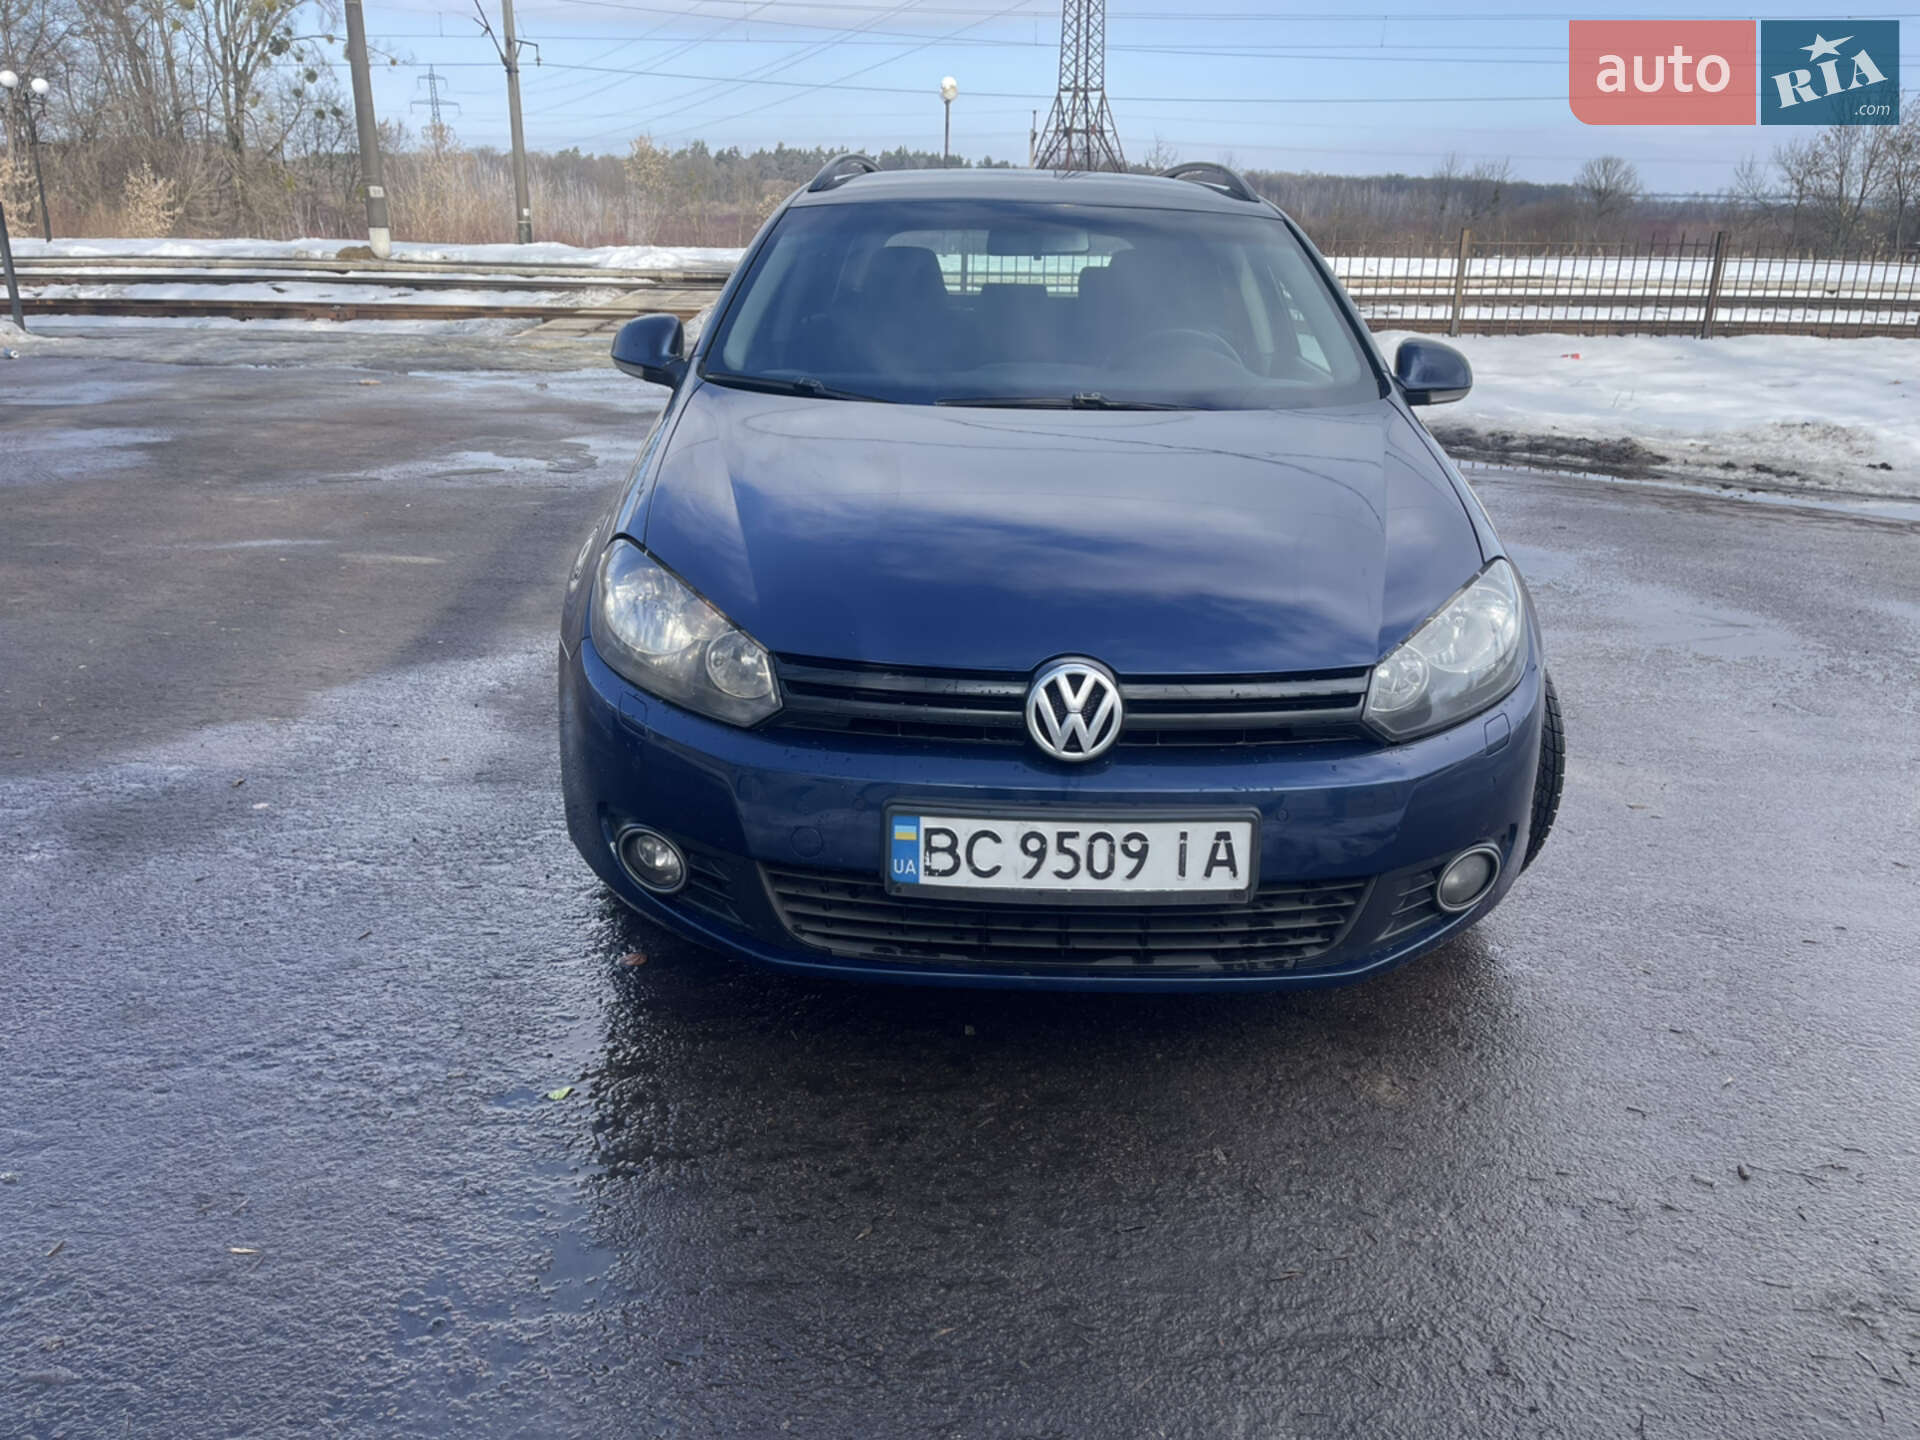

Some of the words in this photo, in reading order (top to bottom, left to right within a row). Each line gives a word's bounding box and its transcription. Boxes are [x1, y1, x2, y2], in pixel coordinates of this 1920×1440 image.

[1030, 667, 1118, 757] VW
[893, 859, 917, 875] UA
[923, 827, 1002, 879] BC
[1020, 831, 1150, 880] 9509
